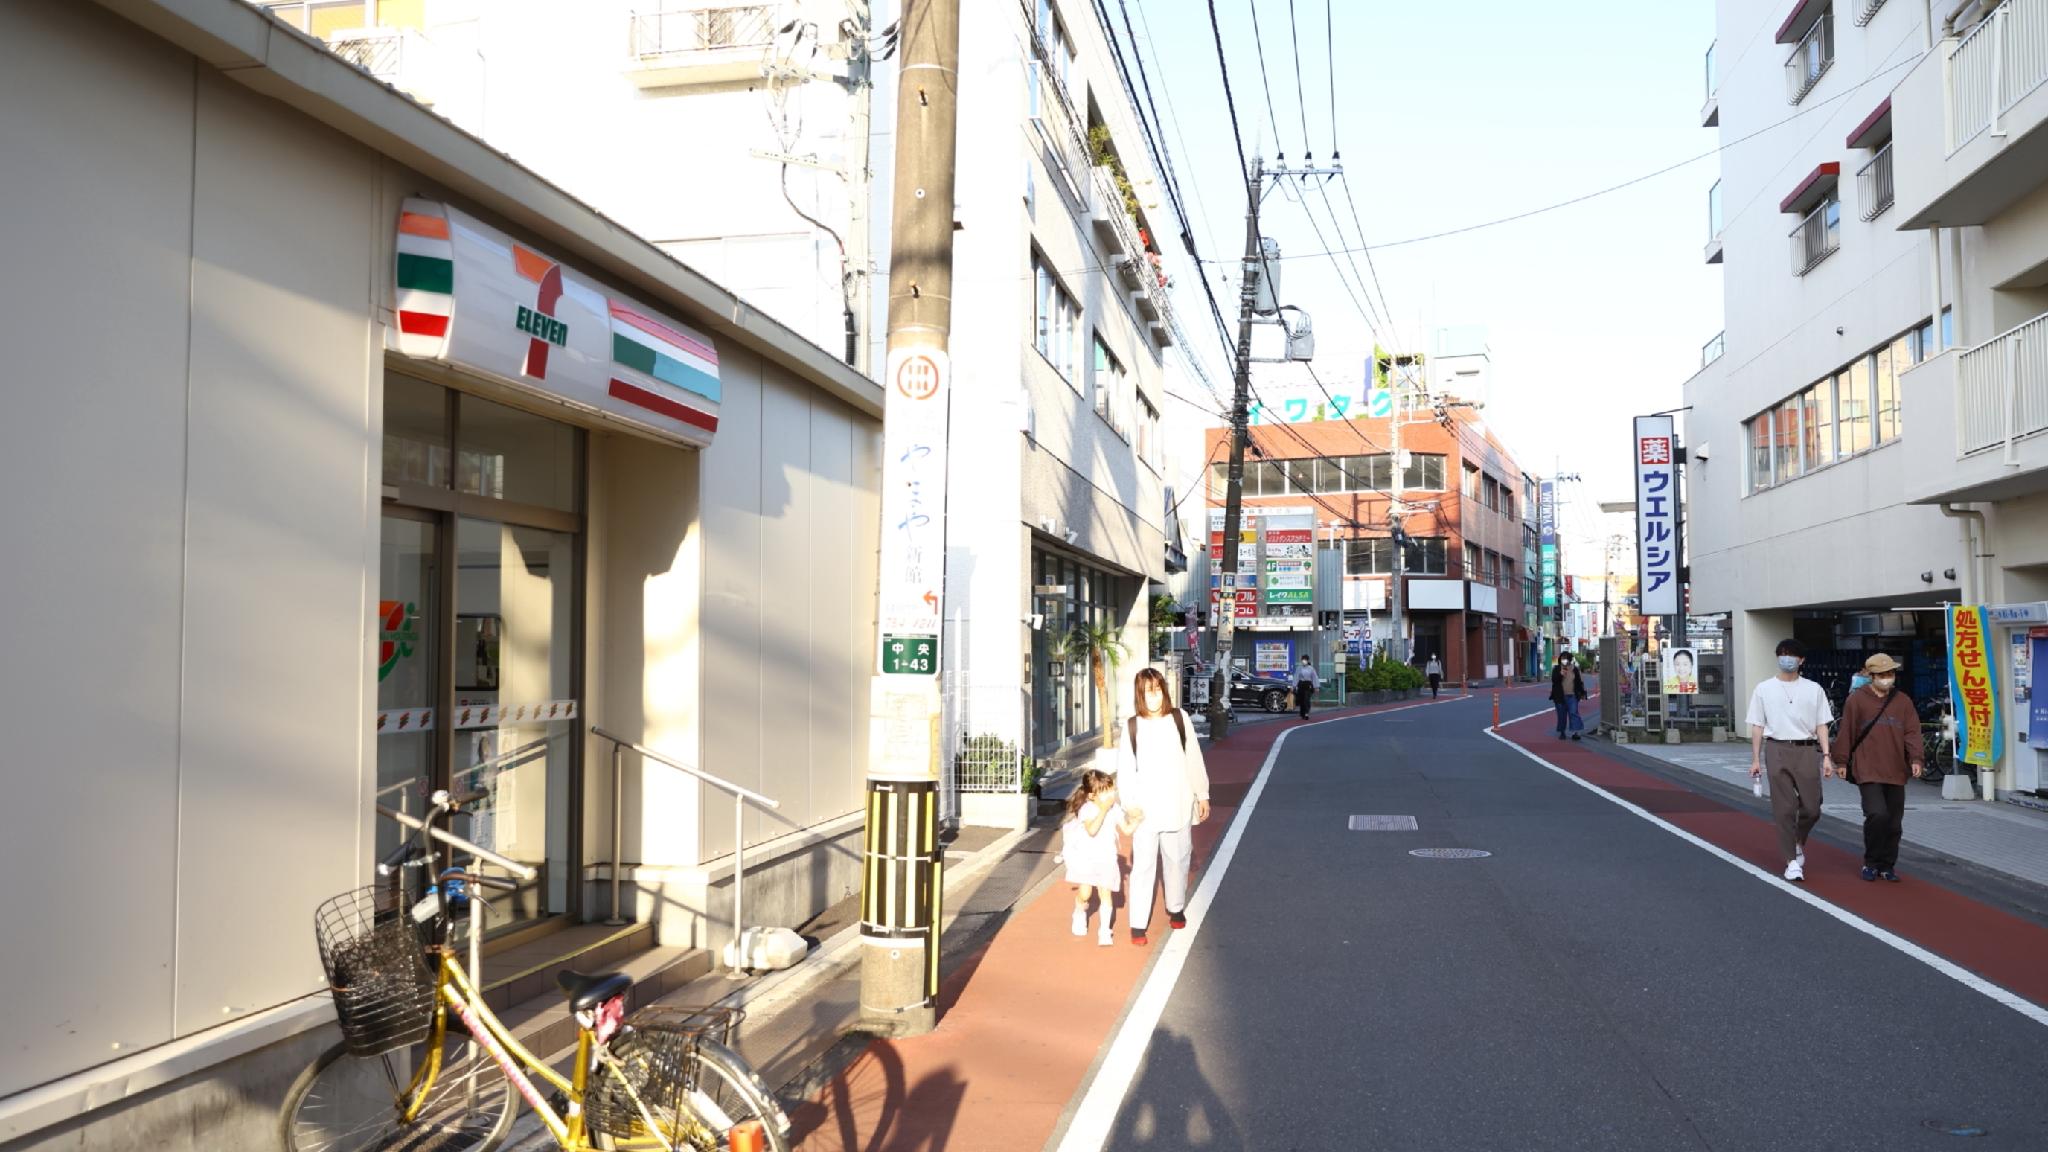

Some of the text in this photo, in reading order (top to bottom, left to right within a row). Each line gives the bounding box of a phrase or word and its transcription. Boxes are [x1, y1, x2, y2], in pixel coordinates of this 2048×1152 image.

[1642, 438, 1671, 592] 薬 ウエルシア
[1270, 591, 1309, 599] レイクALSA
[891, 642, 930, 656] 中央
[892, 658, 928, 671] 1-43
[1955, 609, 1991, 727] 処方せん受付
